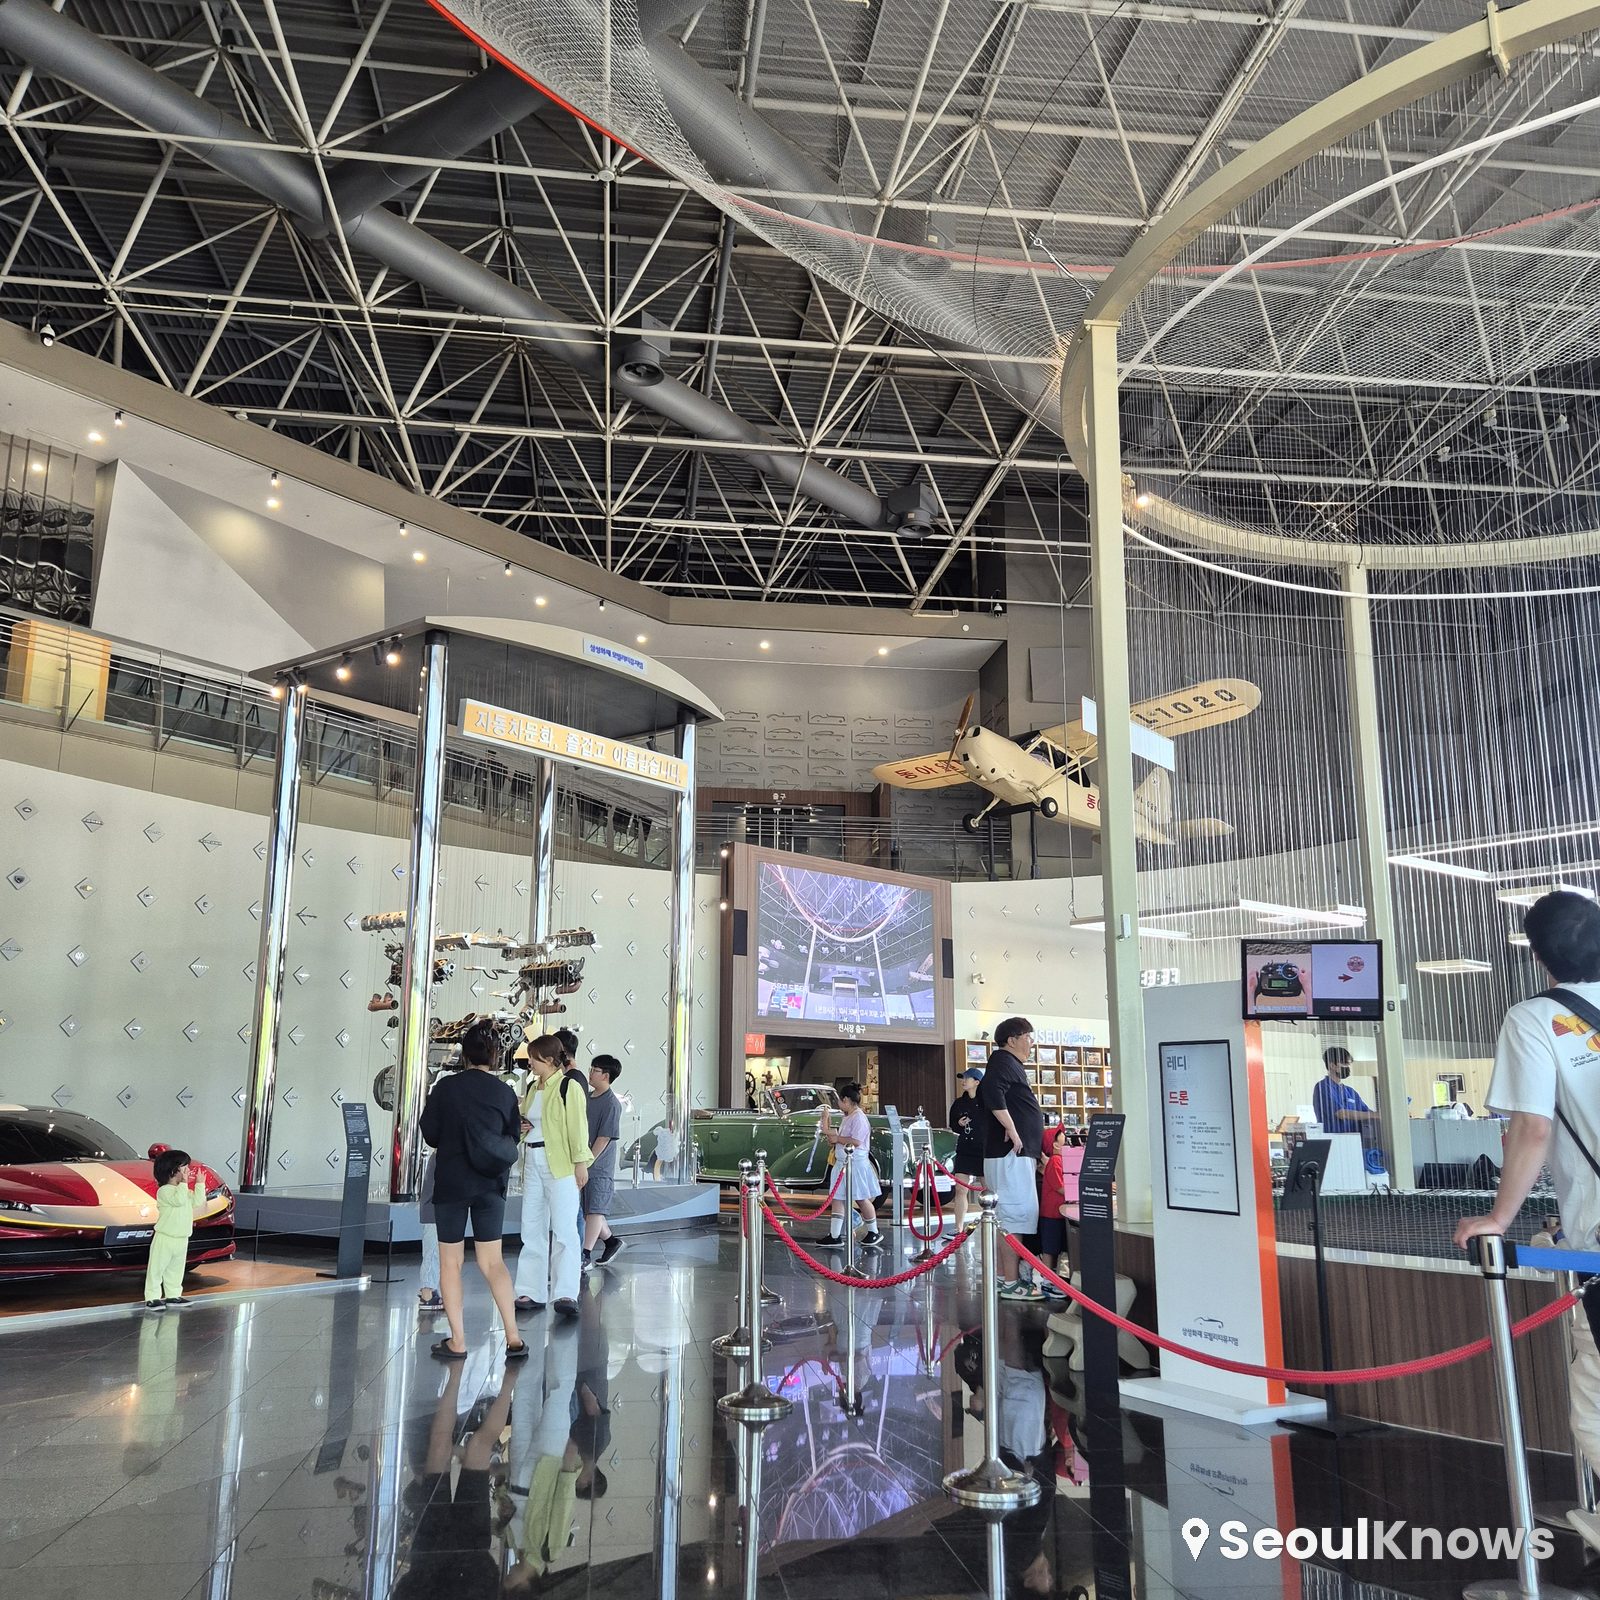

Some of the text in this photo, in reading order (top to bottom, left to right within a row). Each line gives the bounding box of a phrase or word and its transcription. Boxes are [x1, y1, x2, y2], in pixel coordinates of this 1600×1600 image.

[474, 711, 559, 750] 자동차문화,
[565, 733, 606, 759] 즐겁고
[1166, 1055, 1187, 1071] 레디
[1168, 1090, 1189, 1106] 드론
